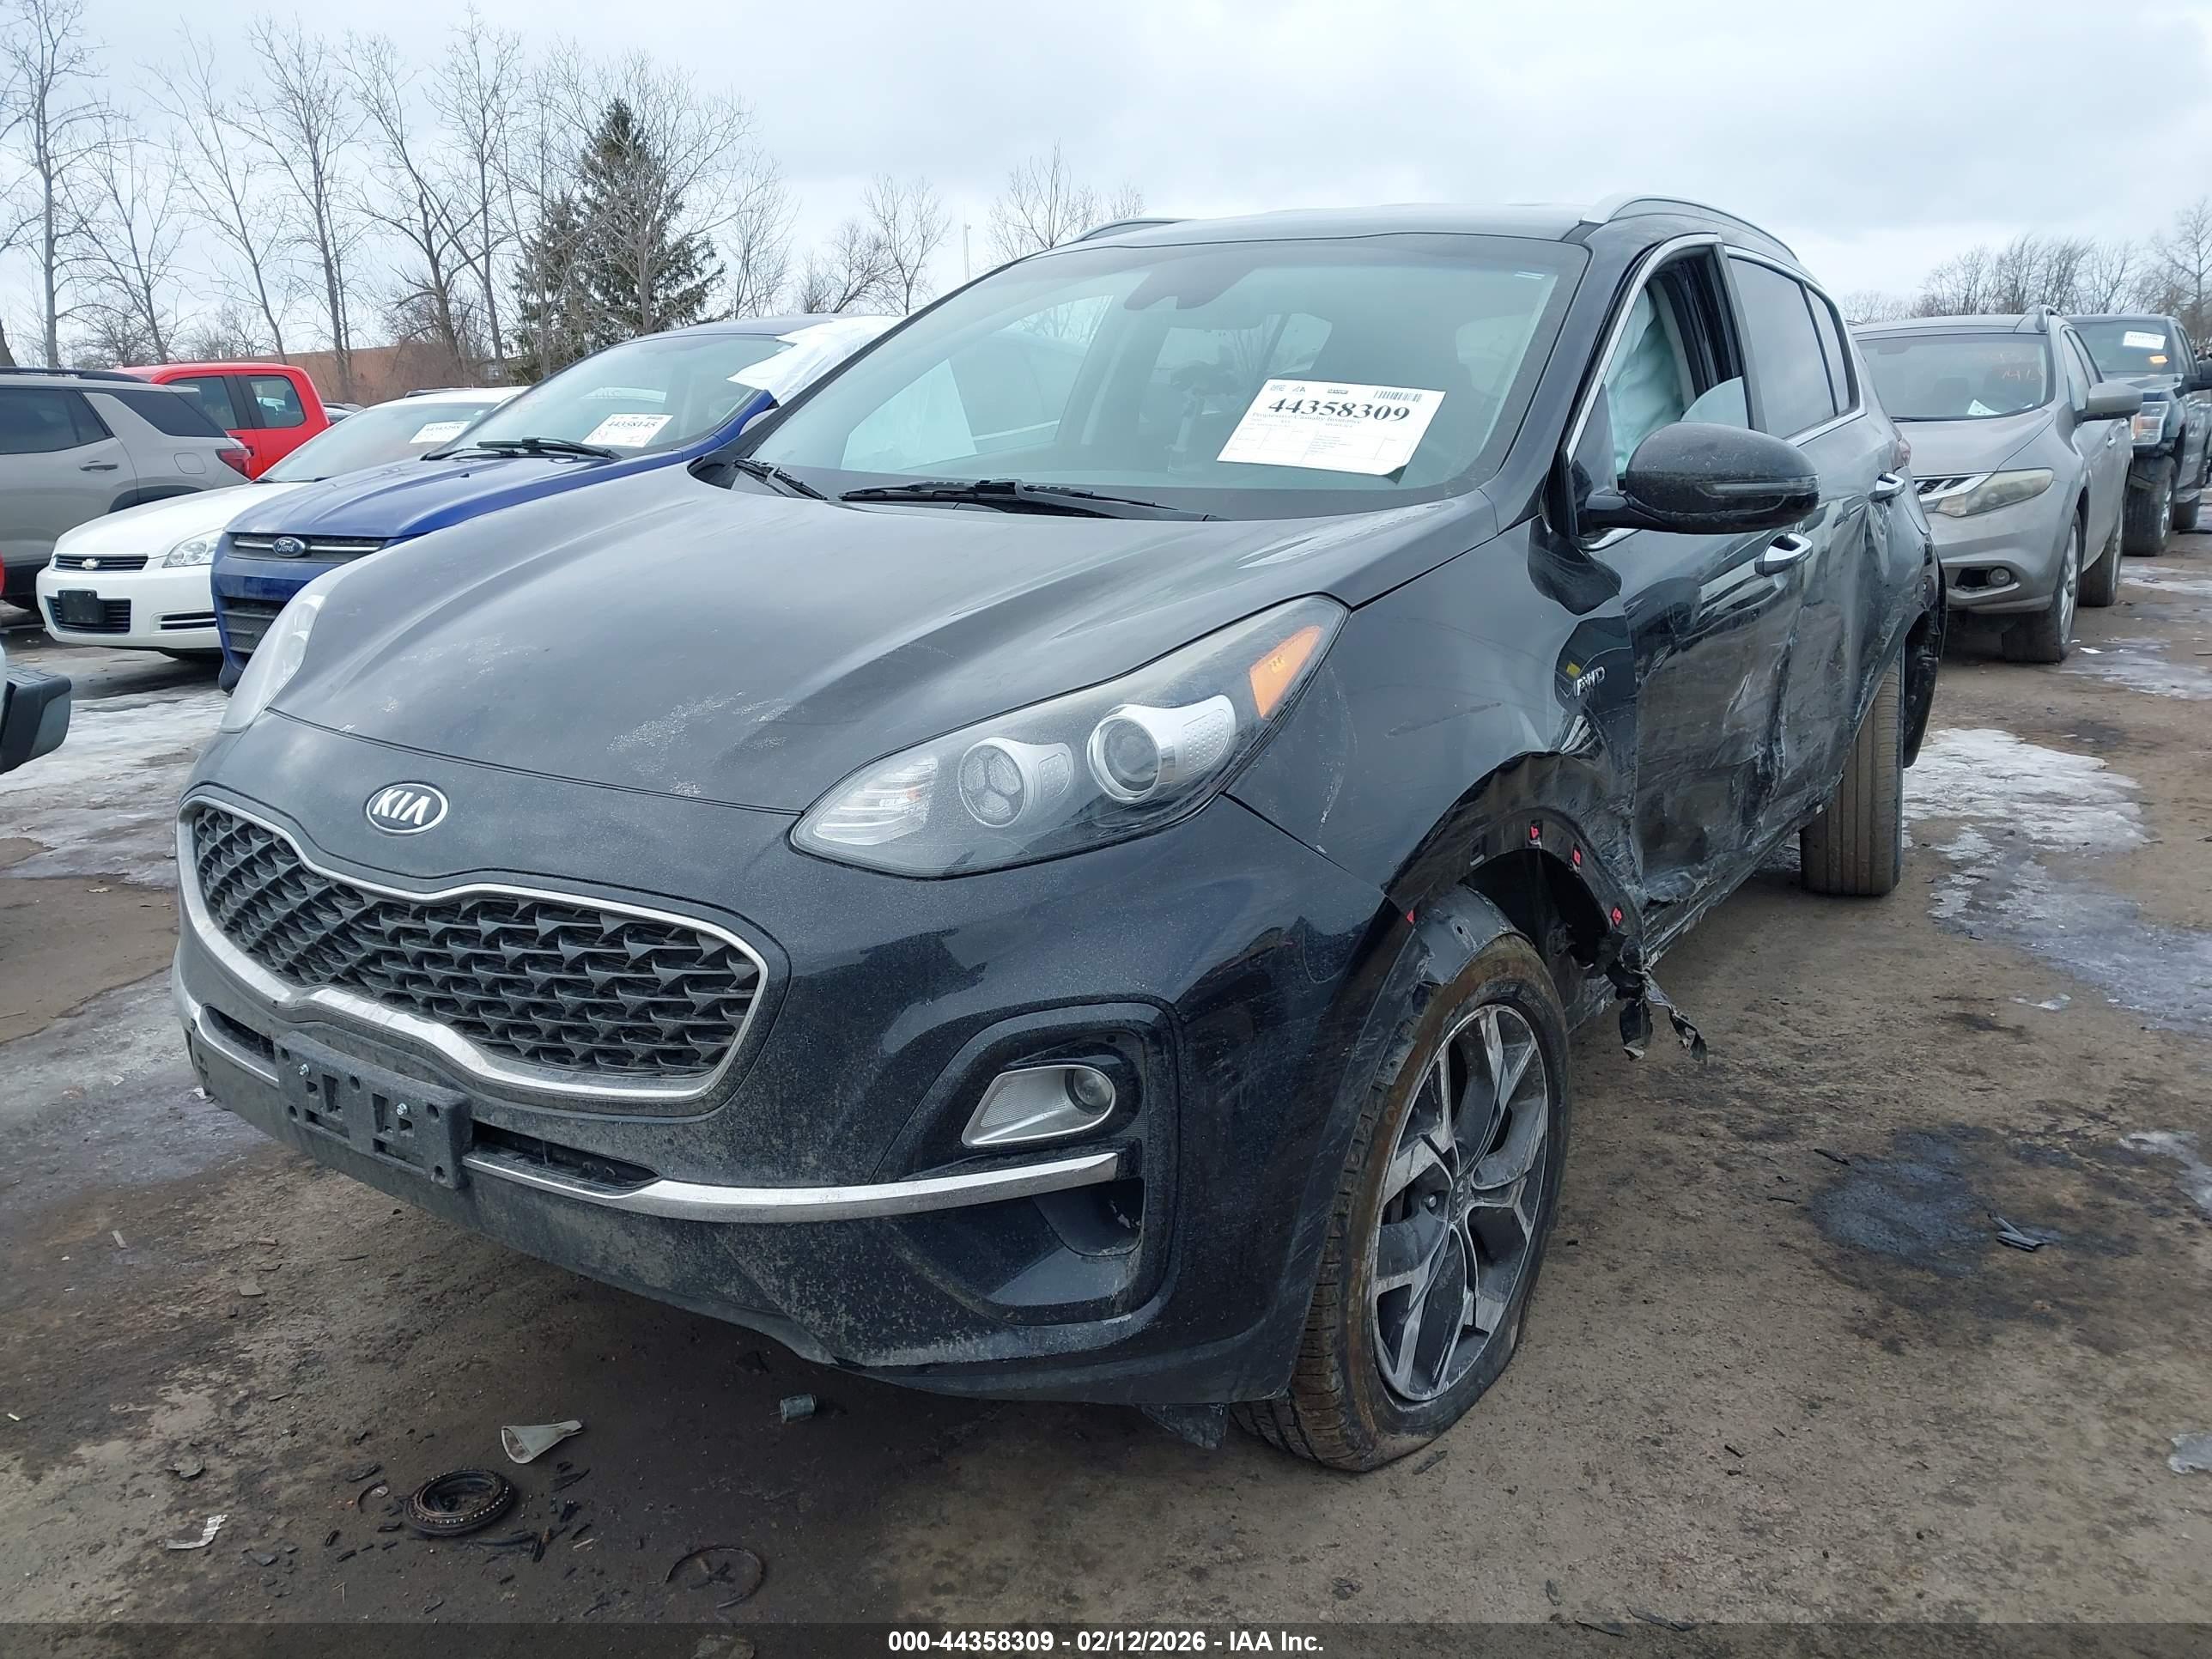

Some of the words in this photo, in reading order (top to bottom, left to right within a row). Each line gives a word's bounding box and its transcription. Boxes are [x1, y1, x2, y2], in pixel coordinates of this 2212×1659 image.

[1268, 398, 1410, 422] 44358309
[276, 539, 295, 552] Ford
[372, 788, 431, 825] KIA
